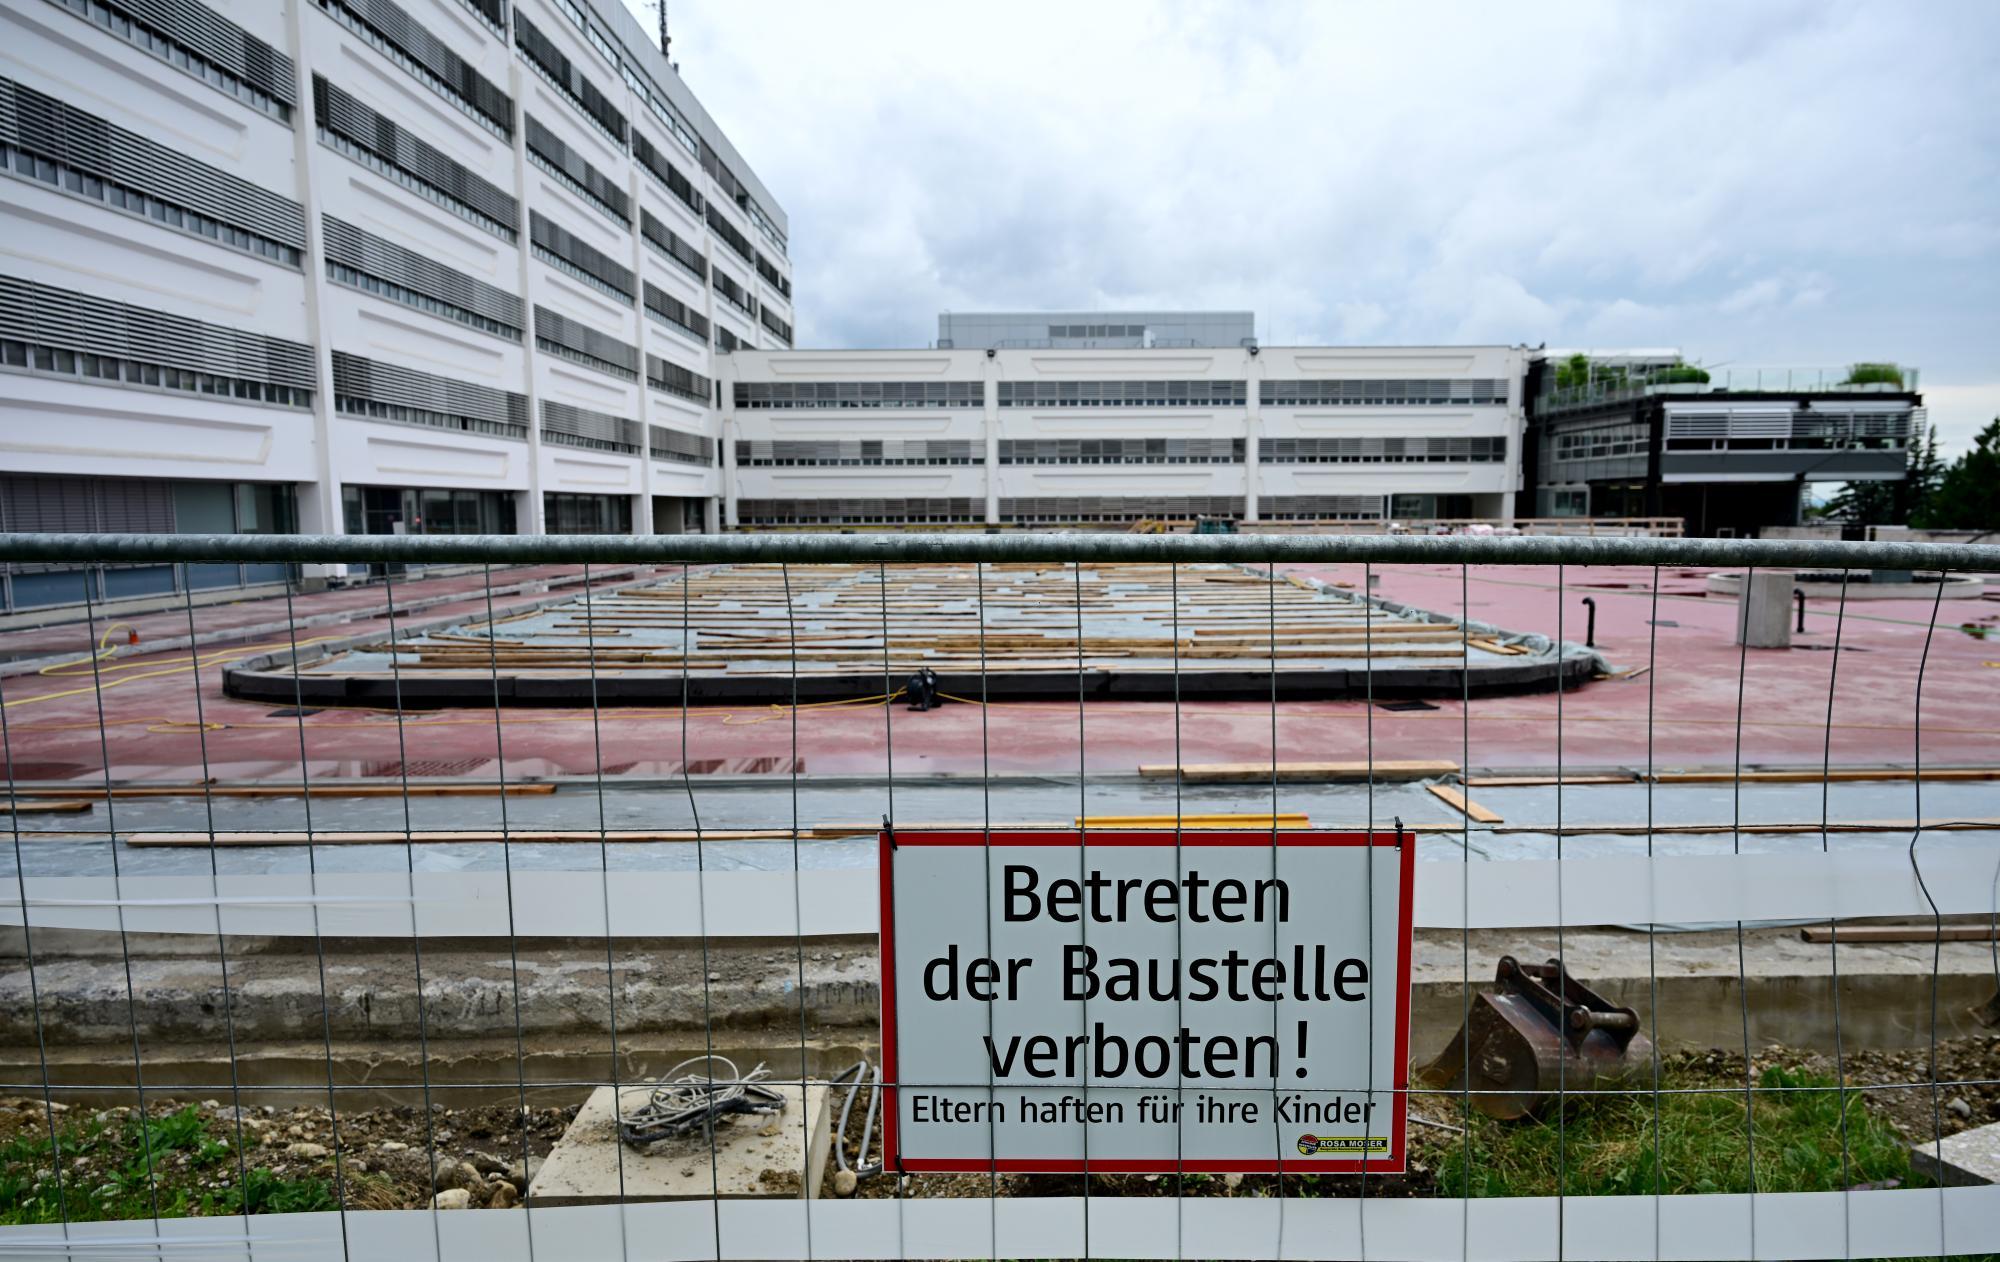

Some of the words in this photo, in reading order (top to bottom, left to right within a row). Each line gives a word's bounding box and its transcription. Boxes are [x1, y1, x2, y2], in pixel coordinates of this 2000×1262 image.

[1004, 864, 1289, 923] Betreten
[923, 944, 1032, 1001] der
[1063, 944, 1369, 1001] Baustelle
[912, 1095, 1004, 1123] Eltern
[1020, 1096, 1123, 1123] haften
[1137, 1095, 1184, 1124] für
[1197, 1095, 1259, 1123] ihre
[1274, 1095, 1376, 1124] Kinder
